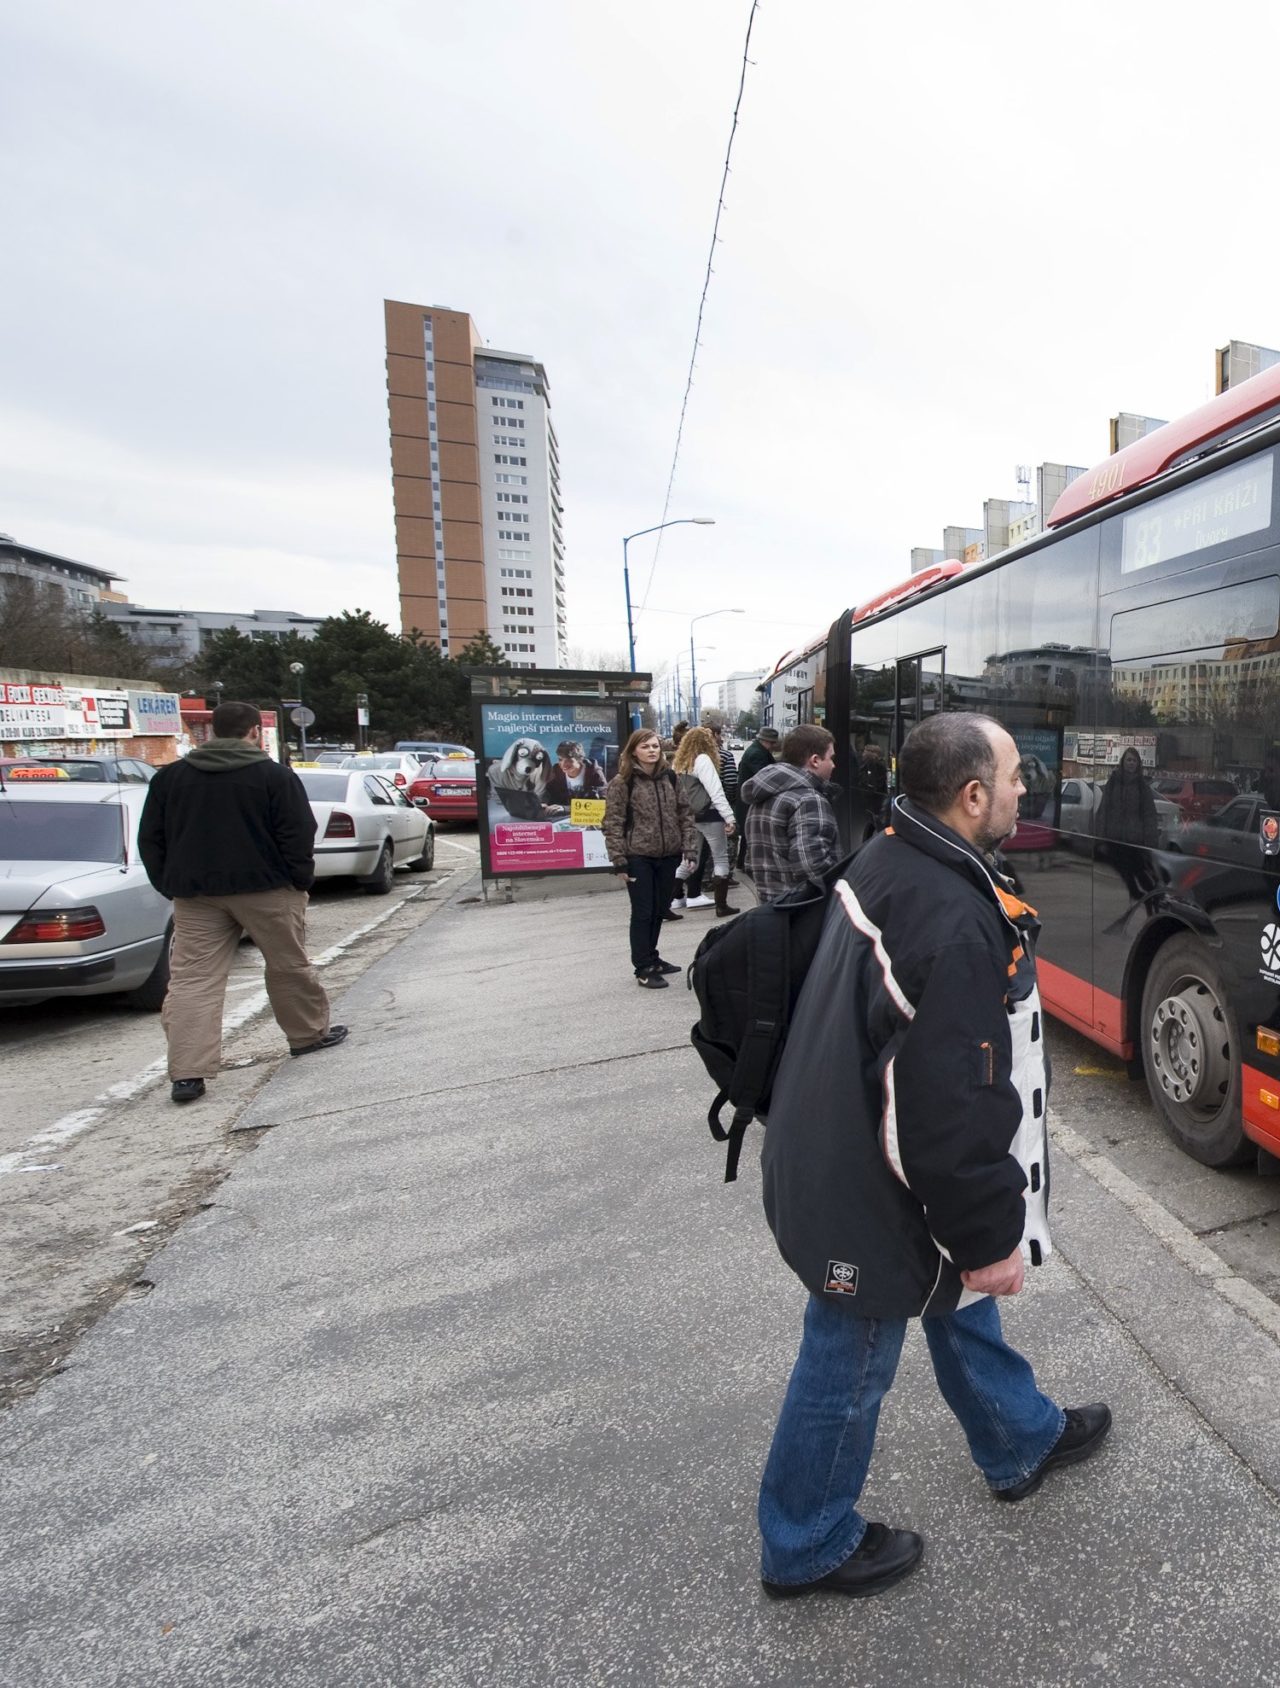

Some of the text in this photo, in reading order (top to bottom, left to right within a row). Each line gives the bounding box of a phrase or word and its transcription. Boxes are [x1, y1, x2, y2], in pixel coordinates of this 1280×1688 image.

[1088, 462, 1126, 500] 4901
[1134, 515, 1162, 567] 83
[487, 711, 563, 722] Magio internet
[497, 723, 538, 734] najlepší
[540, 723, 575, 734] priateľ
[575, 723, 612, 733] človeka
[575, 801, 593, 811] 9 €
